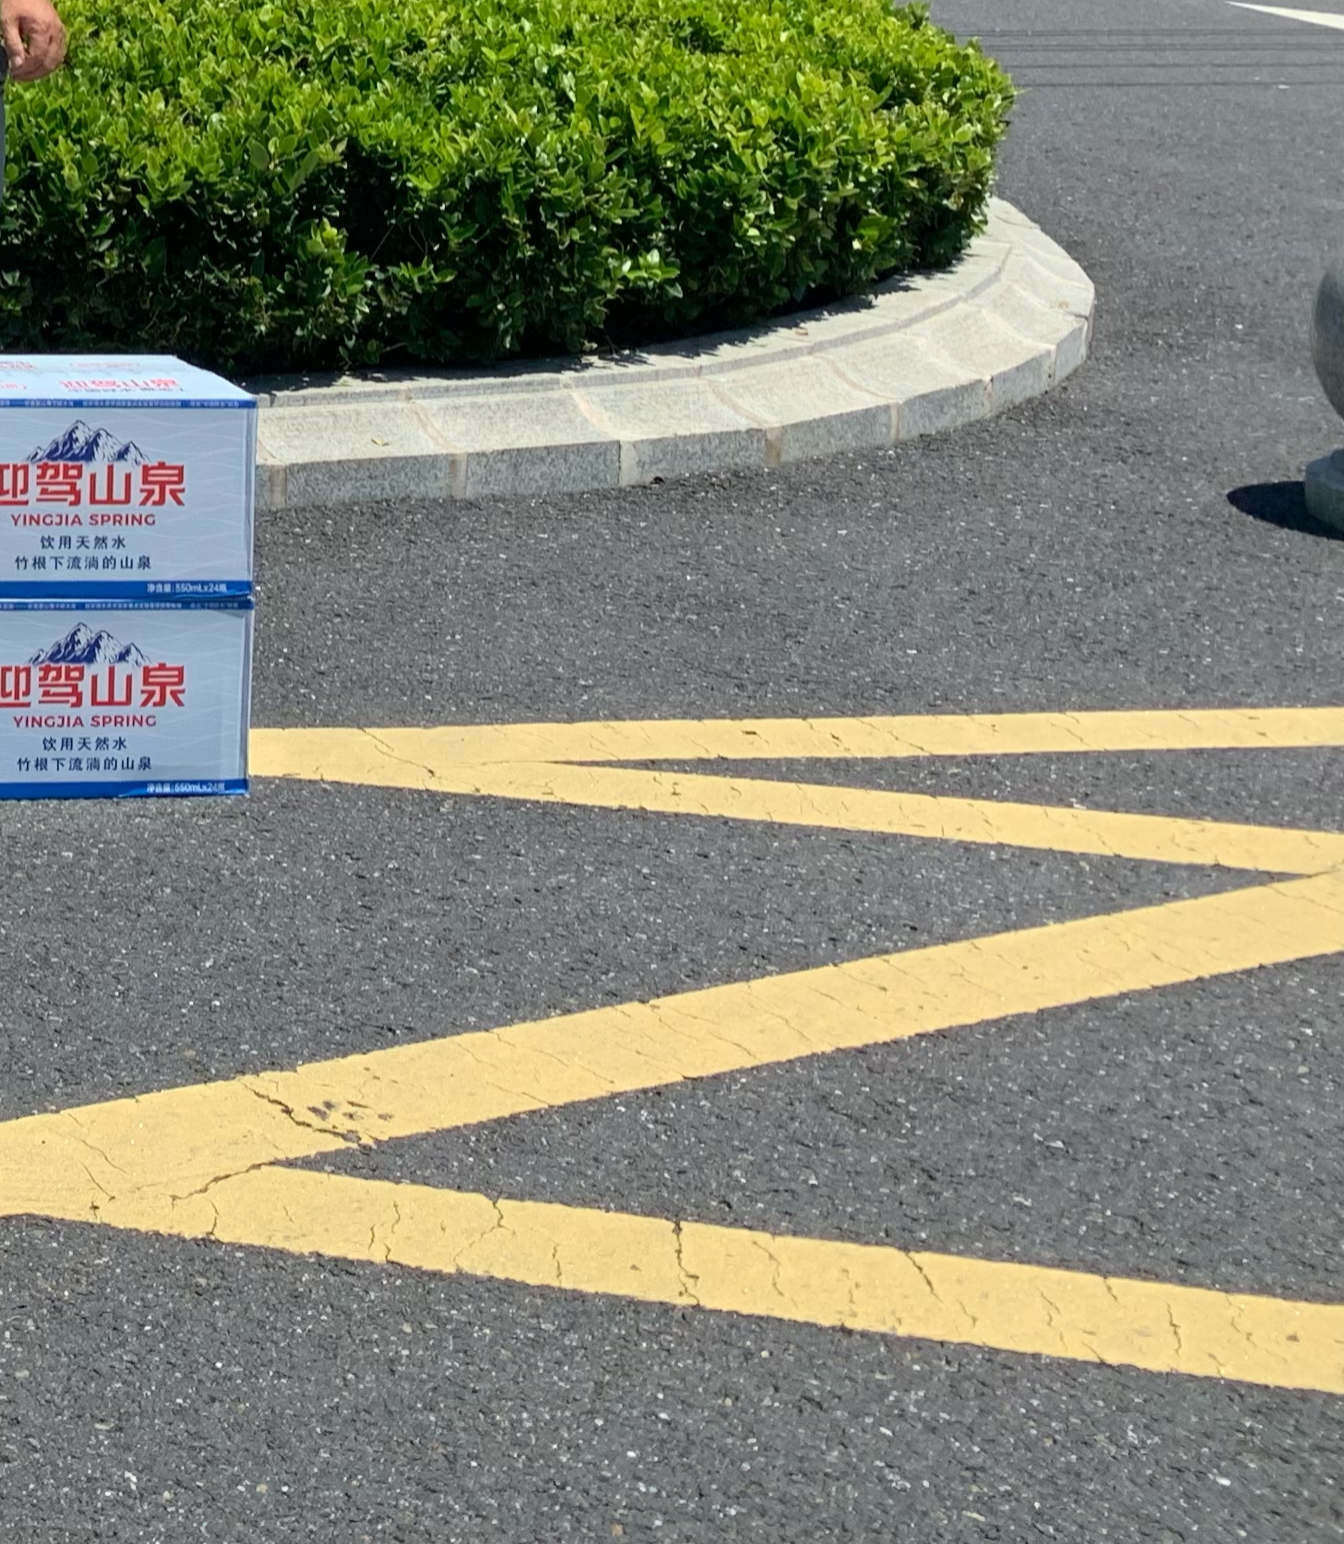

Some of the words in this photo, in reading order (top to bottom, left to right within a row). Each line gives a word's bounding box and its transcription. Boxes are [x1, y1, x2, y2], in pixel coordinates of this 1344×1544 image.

[11, 514, 83, 527] YINGJIA
[90, 514, 156, 526] SPRING
[39, 535, 126, 550] 饮用天然水
[15, 555, 151, 571] 竹根下流淌的山泉
[14, 716, 85, 729] YINGJIA
[91, 715, 157, 728] SPRING
[42, 736, 127, 752] 饮用天然水
[17, 756, 152, 771] 竹根下流淌的山泉
